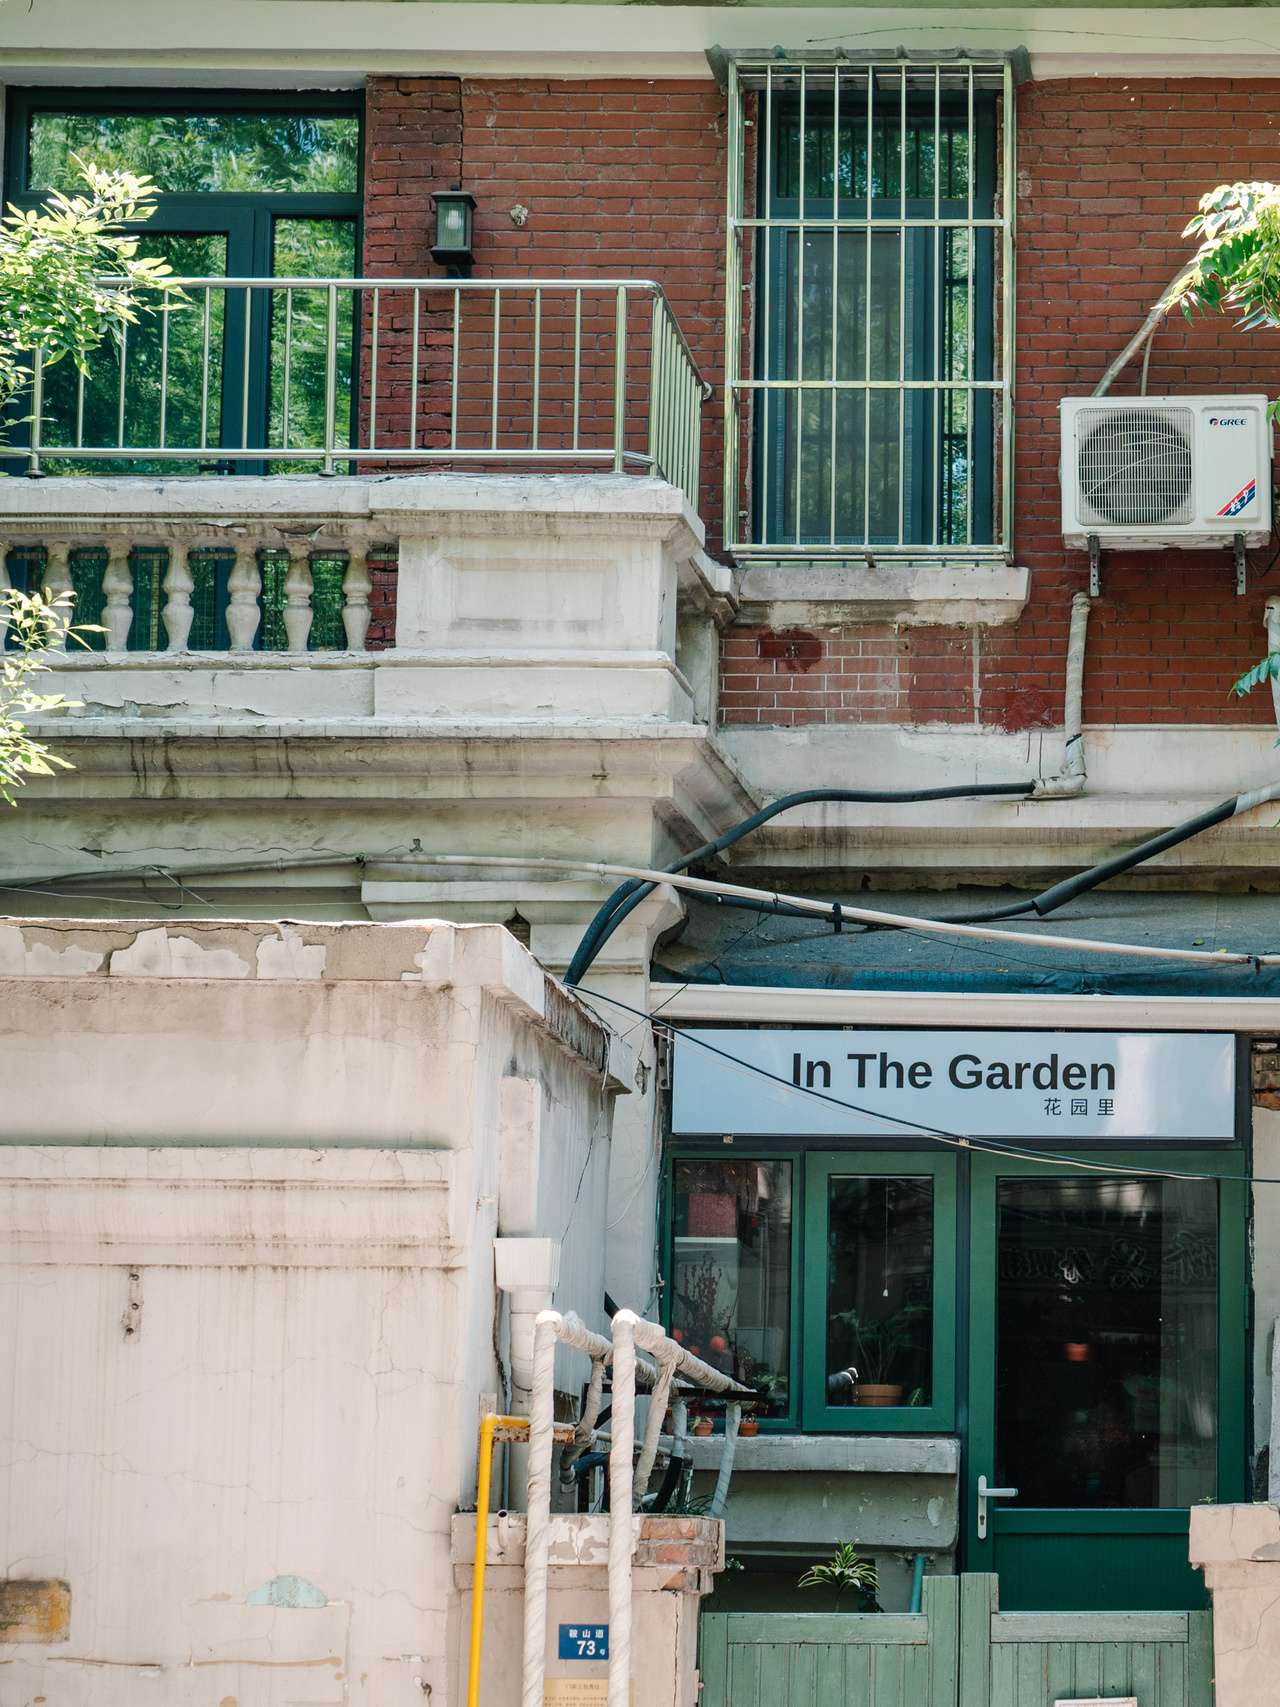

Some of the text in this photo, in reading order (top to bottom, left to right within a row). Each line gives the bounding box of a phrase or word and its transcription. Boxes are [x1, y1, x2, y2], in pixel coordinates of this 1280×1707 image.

[1219, 418, 1247, 426] GREE
[792, 1053, 1116, 1091] In The Garden
[1043, 1098, 1116, 1116] 花园里
[568, 1629, 604, 1639] 鞍山道
